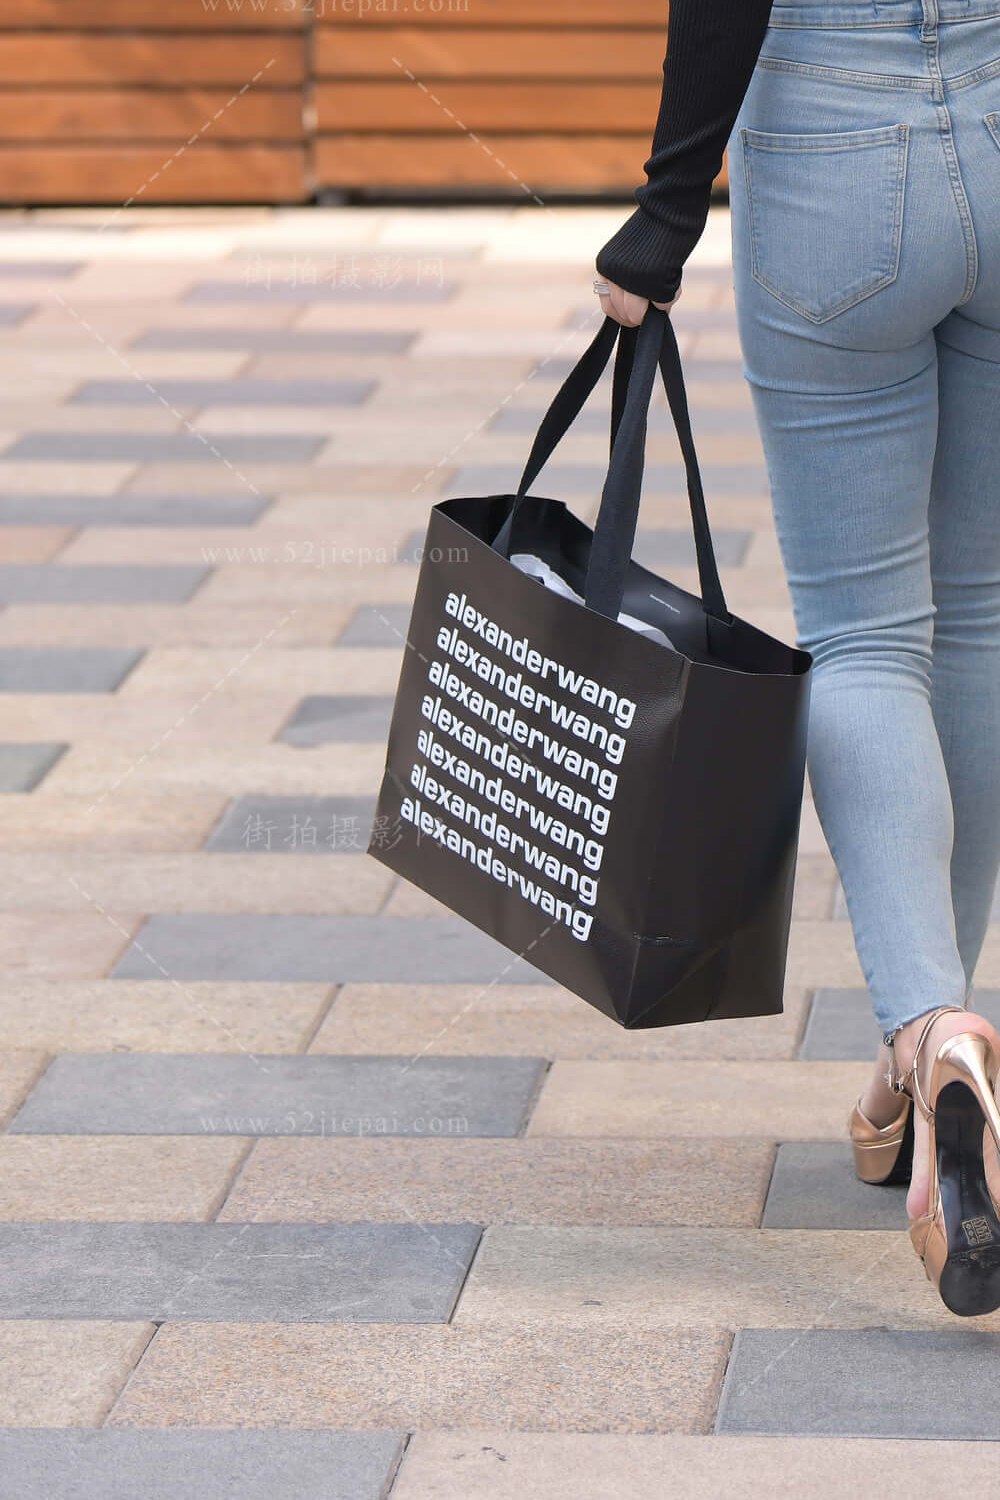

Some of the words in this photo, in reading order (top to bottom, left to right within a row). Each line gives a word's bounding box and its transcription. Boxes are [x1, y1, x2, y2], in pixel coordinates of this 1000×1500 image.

[437, 627, 626, 764] alexanderwang
[446, 593, 636, 729] alexanderwang
[418, 730, 603, 870] alexanderwang
[421, 696, 610, 835] alexanderwang
[429, 662, 617, 800] alexanderwang
[401, 798, 593, 941] alexanderwang
[411, 764, 598, 905] alexanderwang
